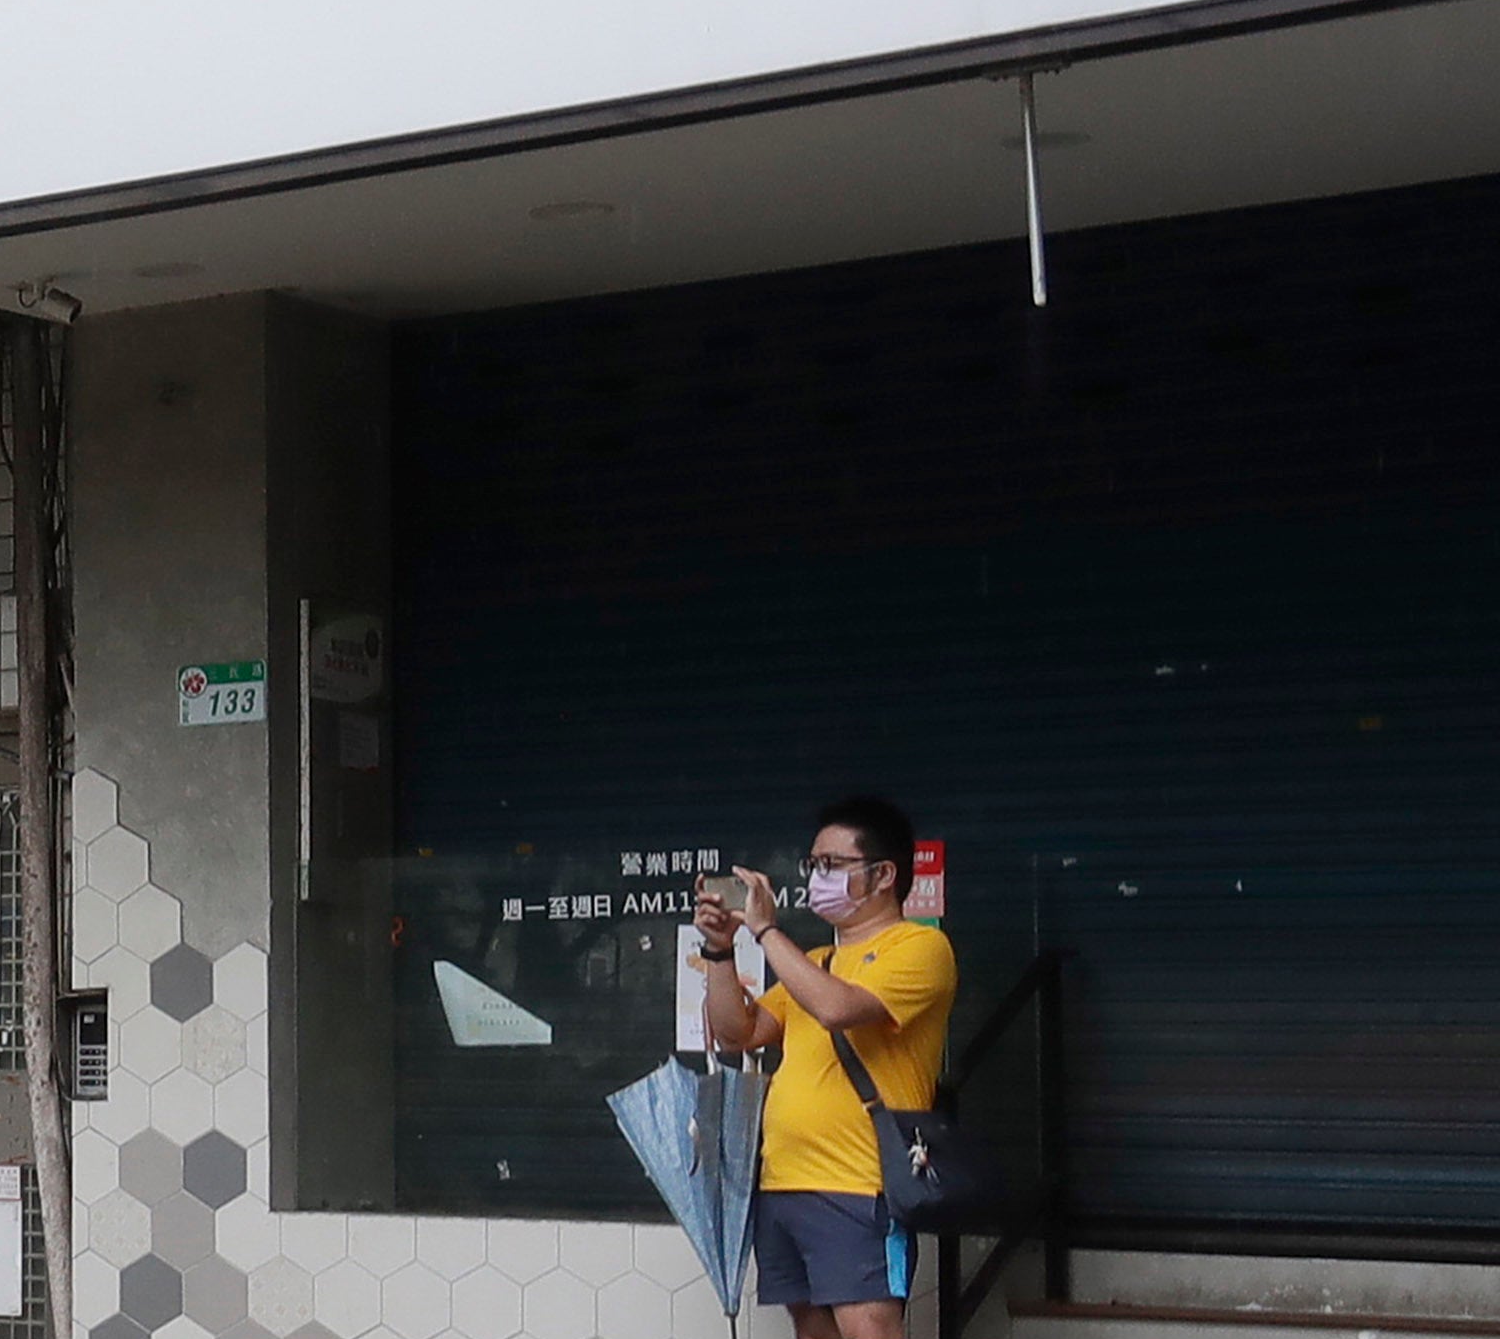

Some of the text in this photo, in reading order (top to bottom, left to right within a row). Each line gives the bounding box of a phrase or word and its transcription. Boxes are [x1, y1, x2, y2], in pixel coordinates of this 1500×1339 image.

[209, 688, 256, 717] 133
[621, 849, 719, 876] 營業時間
[502, 894, 612, 921] 週一至週日
